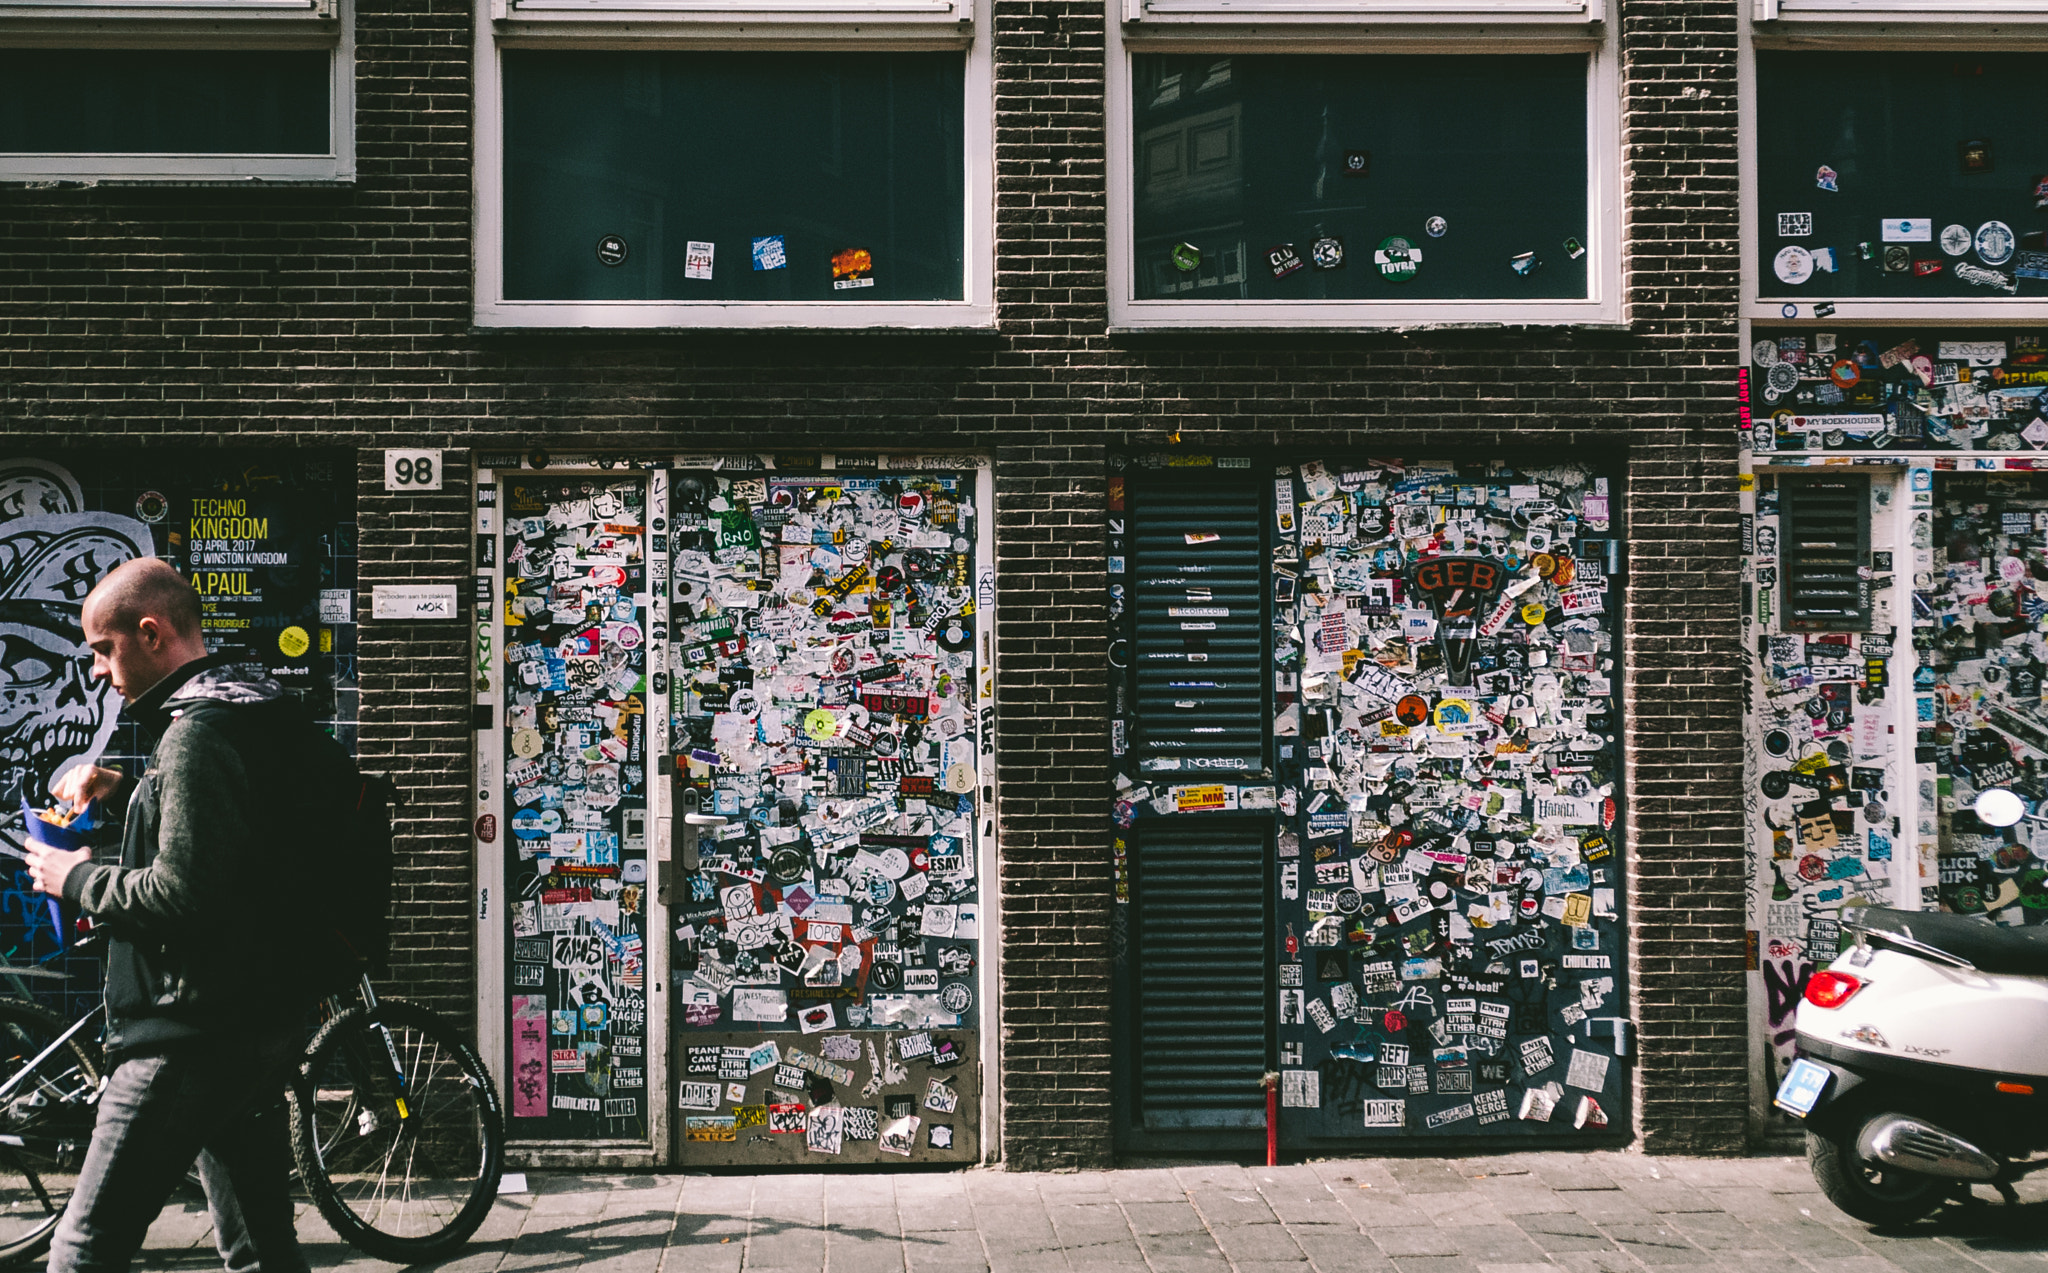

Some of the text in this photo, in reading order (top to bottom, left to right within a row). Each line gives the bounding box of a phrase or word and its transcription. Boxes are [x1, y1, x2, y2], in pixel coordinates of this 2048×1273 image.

[1740, 406, 1751, 428] ARTS
[1806, 417, 1821, 425] MY
[1822, 416, 1881, 425] BOEKHOUDER
[395, 457, 432, 485] 98
[192, 498, 246, 516] TECHNO
[190, 518, 268, 539] KINGDOM
[190, 540, 255, 551] 06 APRIL 2017
[203, 553, 244, 564] WINSTON
[246, 553, 287, 564] KINGDOM
[1578, 561, 1598, 569] MAS
[1578, 570, 1598, 579] PAZ
[191, 572, 252, 595] A.PAUL
[1577, 590, 1599, 600] HAND
[1480, 599, 1512, 635] Prosto
[514, 764, 538, 777] TWIN
[516, 771, 540, 784] SHOP
[1979, 769, 2014, 788] ARMY
[1203, 792, 1223, 803] MM
[930, 857, 959, 871] ESAY
[1308, 890, 1334, 902] ROOTS
[1814, 921, 1838, 931] UTAH
[1810, 931, 1840, 941] ETHER
[1812, 943, 1837, 952] UTAH
[1808, 952, 1839, 961] ETHER
[905, 976, 937, 986] JUMBO
[611, 1011, 644, 1022] RAGUE
[1448, 1015, 1473, 1023] UTAH
[1446, 1024, 1476, 1032] ETHER
[1481, 1017, 1505, 1029] UTAH
[1477, 1024, 1507, 1038] ETHER
[614, 1037, 640, 1045] UTAH
[612, 1046, 642, 1055] ETHER
[688, 1047, 720, 1055] PEANE
[1380, 1046, 1409, 1064] REFT
[934, 1053, 959, 1065] RITA
[1523, 1048, 1547, 1067] UTAH
[688, 1064, 717, 1073] CAMS
[721, 1061, 746, 1069] UTAH
[1525, 1055, 1554, 1075] ETHER
[615, 1070, 640, 1078] UTAH
[718, 1069, 748, 1078] ETHER
[779, 1066, 803, 1079] UTAH
[1378, 1067, 1405, 1080] ROOTS
[613, 1078, 643, 1087] ETHER
[774, 1074, 805, 1088] ETHER
[1474, 1089, 1506, 1105] KERSM
[1476, 1101, 1508, 1115] SERGE
